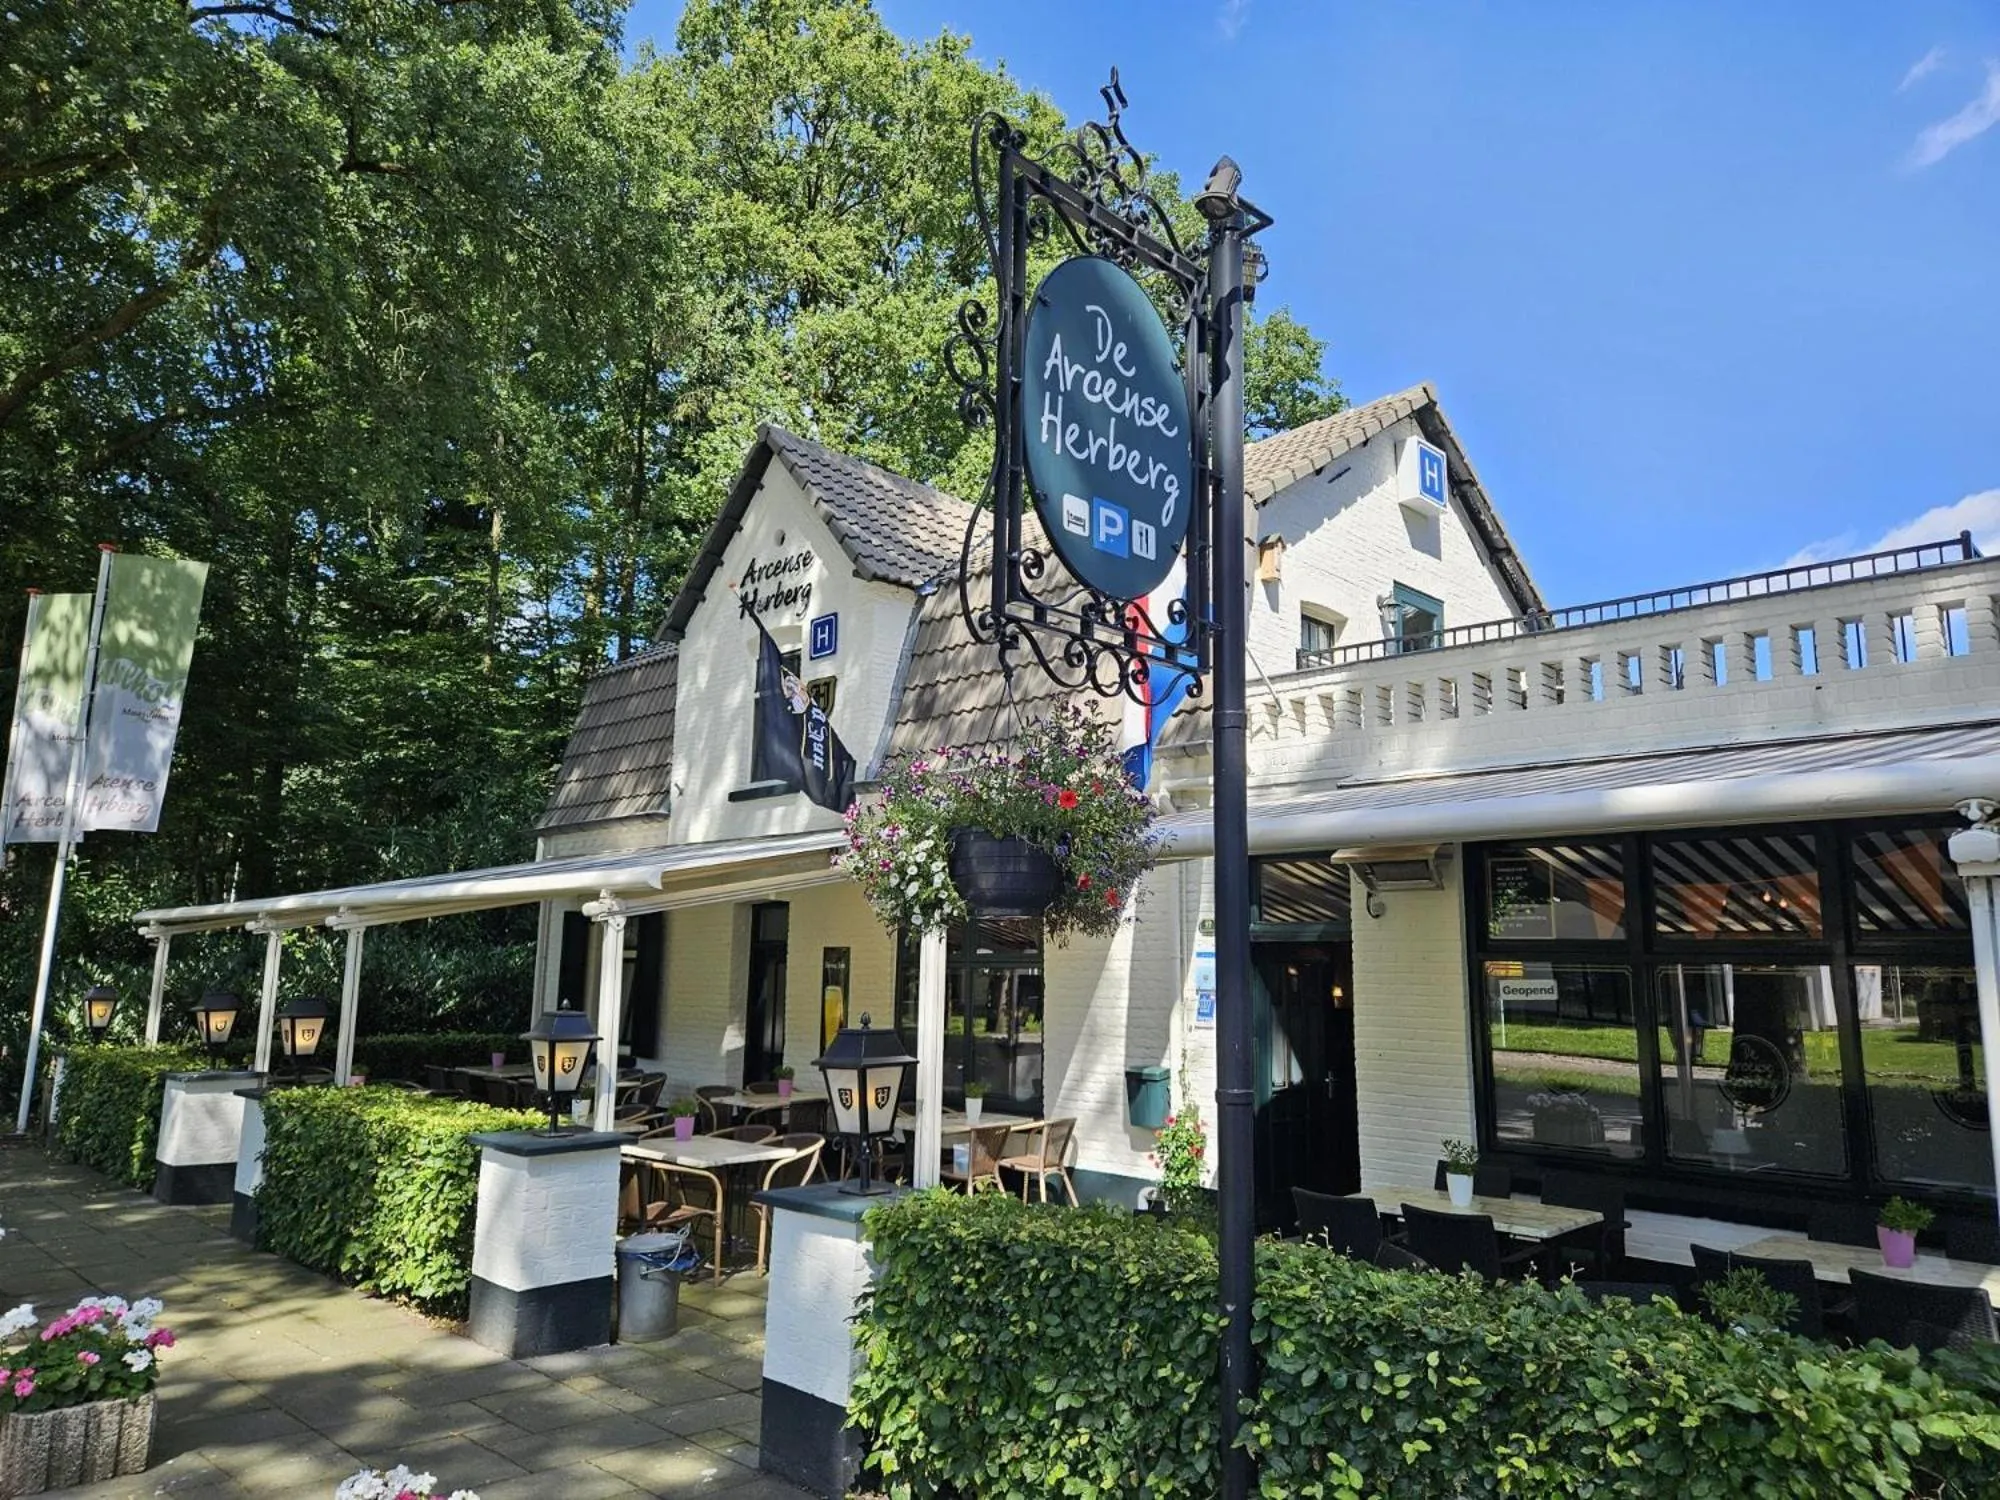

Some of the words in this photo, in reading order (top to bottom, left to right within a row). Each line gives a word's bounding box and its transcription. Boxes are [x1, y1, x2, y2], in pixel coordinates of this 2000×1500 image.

[1085, 304, 1137, 378] De
[1043, 333, 1179, 438] Arcense
[1040, 391, 1181, 528] Herberg
[1425, 456, 1439, 493] H
[1099, 506, 1123, 542] P
[740, 549, 815, 589] Arcense
[739, 580, 812, 620] Herberg
[816, 626, 830, 649] H
[1502, 985, 1554, 997] Geopend
